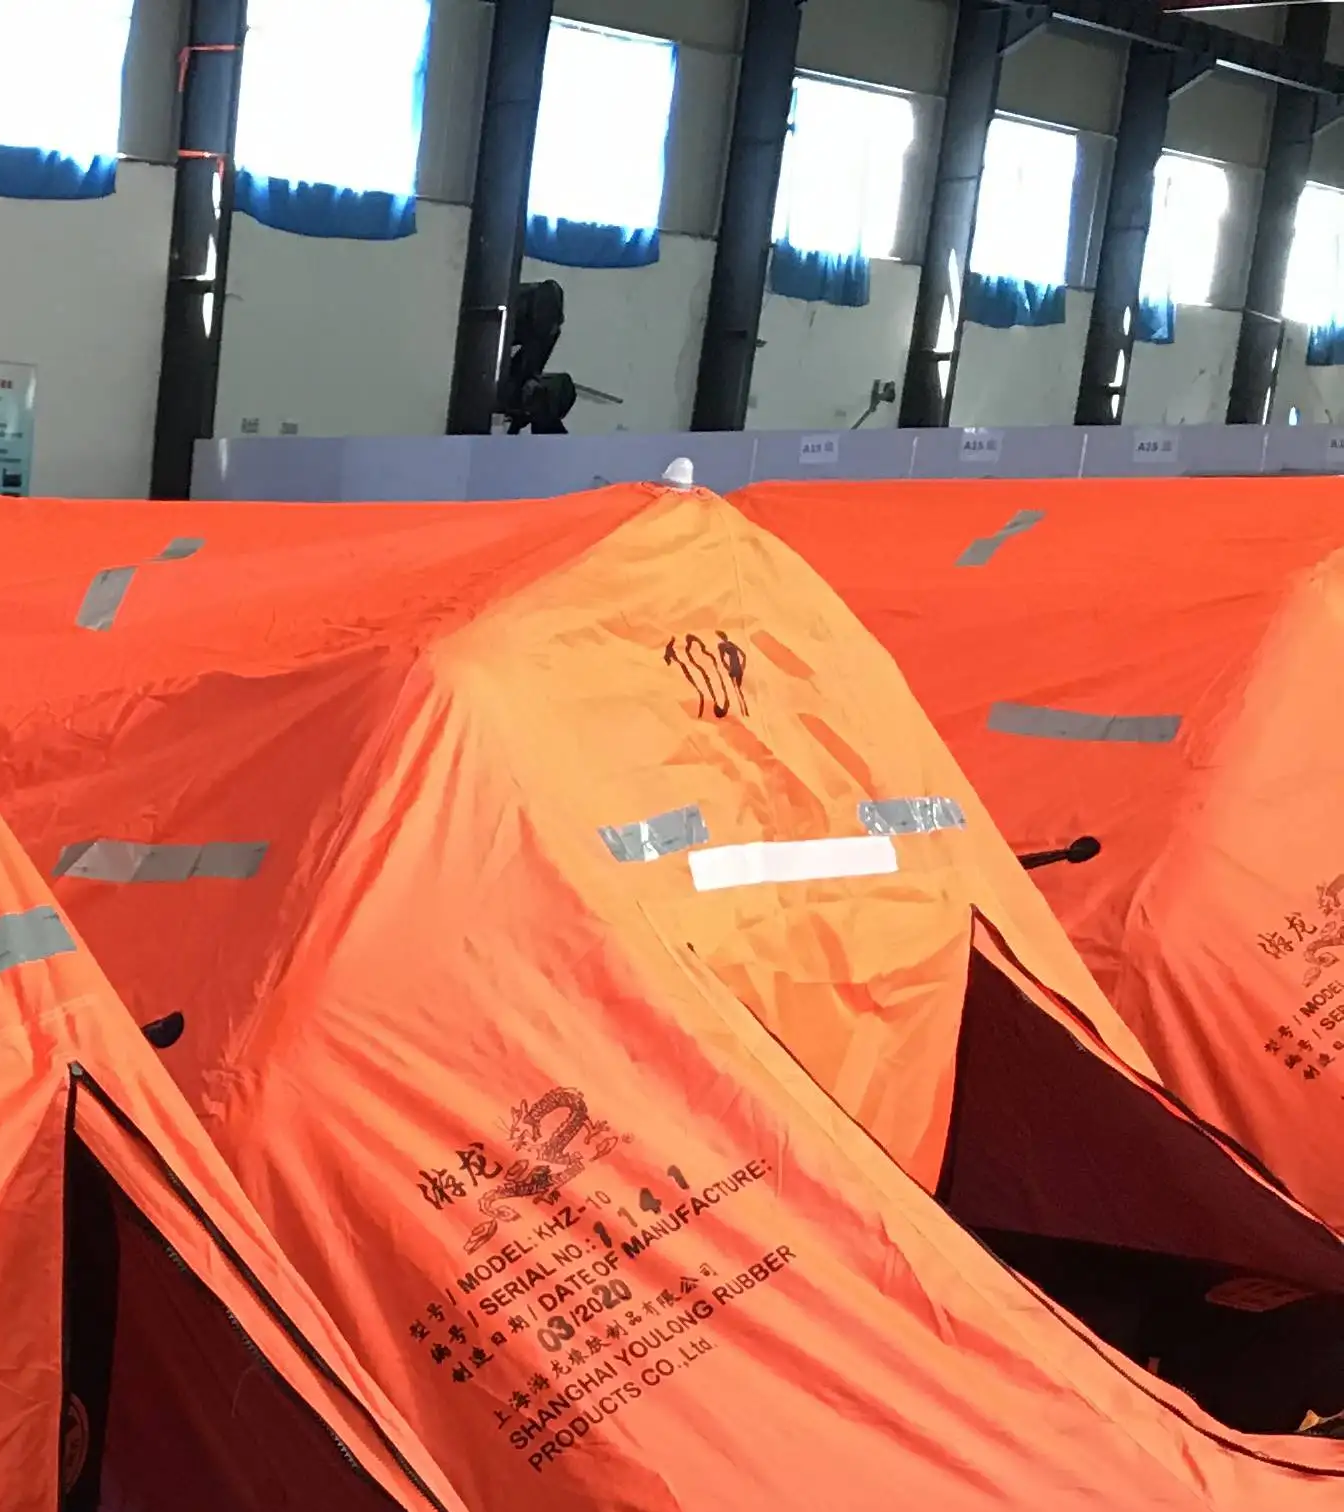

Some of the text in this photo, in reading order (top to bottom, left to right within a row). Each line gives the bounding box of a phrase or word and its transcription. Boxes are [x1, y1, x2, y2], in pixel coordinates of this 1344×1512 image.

[664, 634, 730, 718] 10
[416, 1142, 504, 1210] 游龙
[457, 1236, 539, 1295] MODEL:
[532, 1190, 612, 1241] KHZ-10
[537, 1269, 596, 1312] DATE
[592, 1251, 619, 1277] OF
[621, 1159, 773, 1260] MANUFACTURE:
[479, 1262, 557, 1315] SERIAL
[537, 1279, 632, 1352] 03/2020
[509, 1244, 797, 1450] SHANGHAI YOULONG RUBBER
[528, 1382, 642, 1473] PRODUCTS
